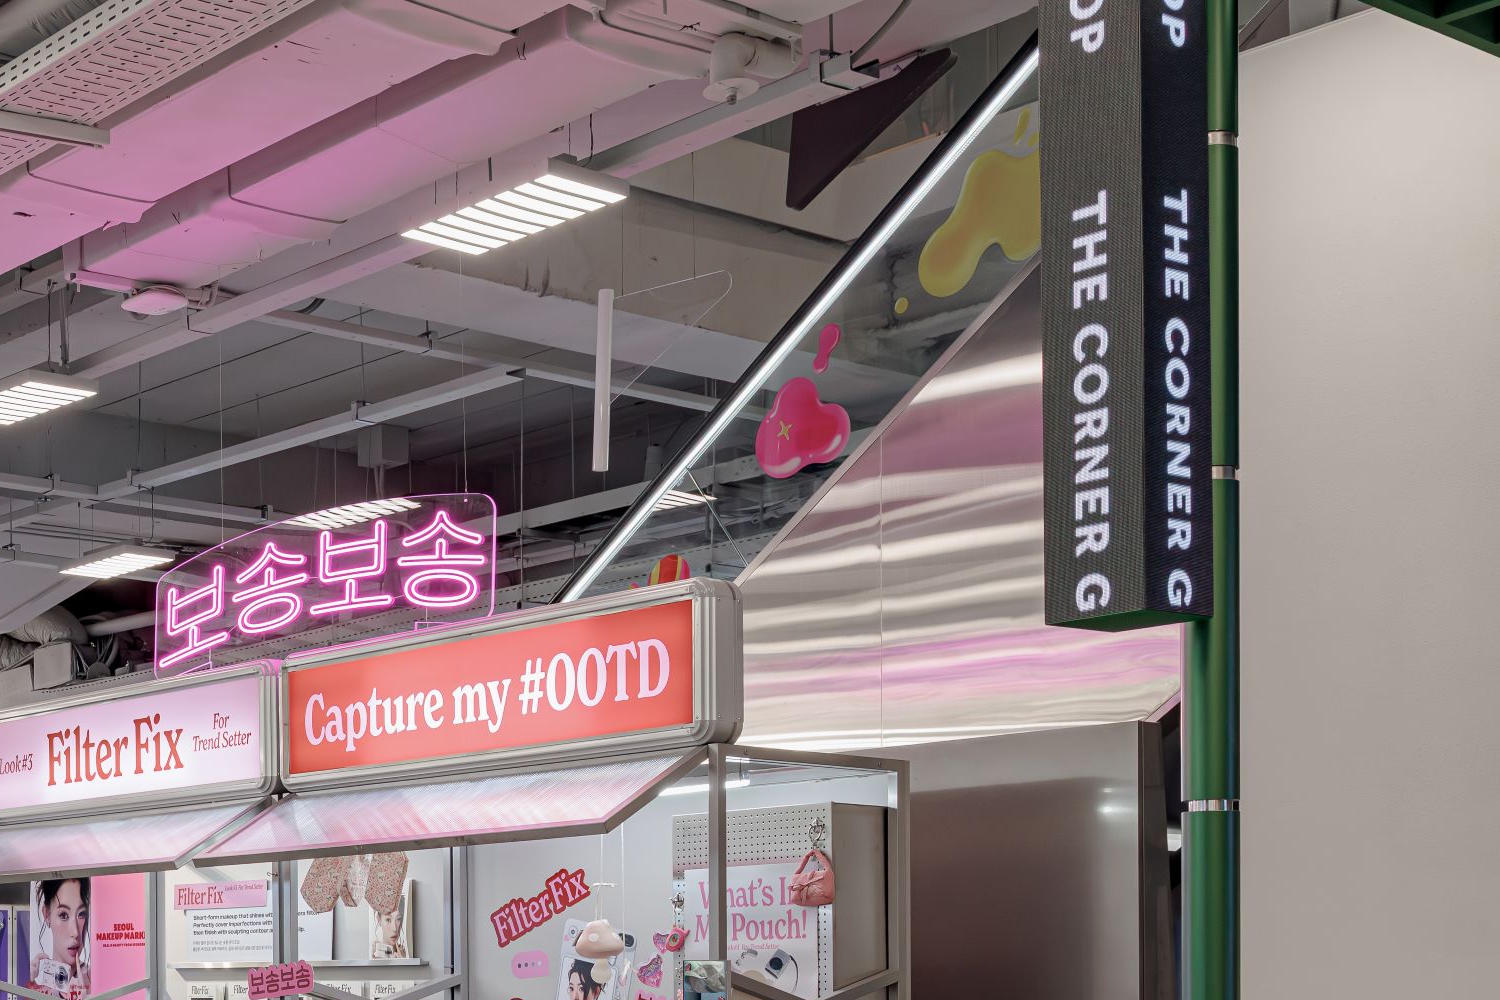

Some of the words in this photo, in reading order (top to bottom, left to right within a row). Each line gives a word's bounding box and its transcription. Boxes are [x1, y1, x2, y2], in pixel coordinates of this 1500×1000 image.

[1072, 190, 1108, 310] THE
[1163, 189, 1189, 301] THE
[1072, 323, 1111, 559] CORNER
[1164, 317, 1192, 551] CORNER
[159, 510, 485, 667] 보송보송
[1075, 572, 1111, 612] G
[1167, 568, 1193, 608] G
[304, 687, 445, 752] Capture
[452, 678, 511, 734] my
[518, 638, 671, 715] #OOTD
[192, 733, 220, 752] Trend
[222, 730, 252, 749] Setter
[212, 711, 230, 731] For
[0, 753, 34, 776] Look#3
[46, 724, 129, 787] Filter
[133, 712, 184, 775] Fix
[177, 888, 207, 906] Filter
[207, 886, 224, 904] Fix
[493, 896, 551, 944] Filter
[548, 872, 589, 911] Fix
[96, 933, 123, 941] MAKEUP
[113, 923, 134, 931] SEOUL
[731, 910, 807, 942] Pouch!
[250, 965, 312, 995] 보송보송
